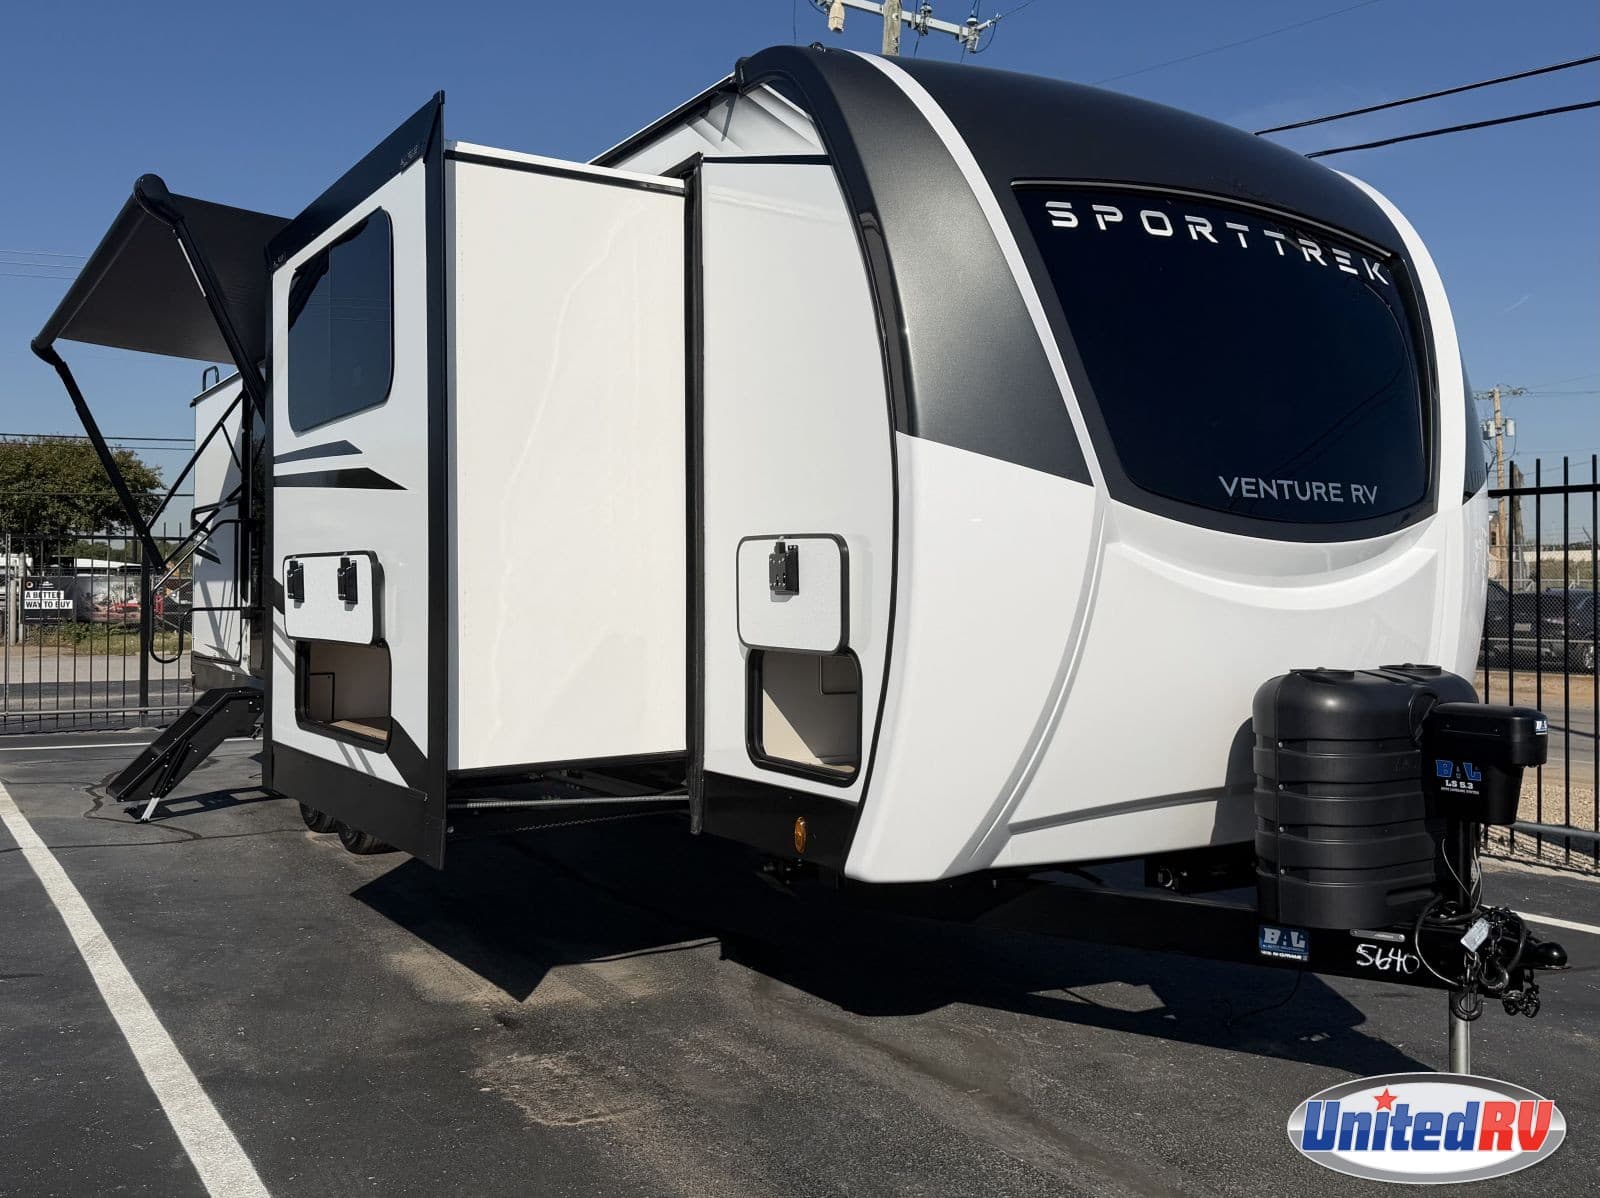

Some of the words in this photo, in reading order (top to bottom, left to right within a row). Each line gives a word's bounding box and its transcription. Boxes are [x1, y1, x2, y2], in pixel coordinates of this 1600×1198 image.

[1045, 201, 1390, 286] SPORTTREK
[1218, 475, 1344, 503] VENTURE
[1350, 483, 1378, 505] RV
[32, 591, 61, 599] BTTE
[1356, 943, 1420, 974] 5640
